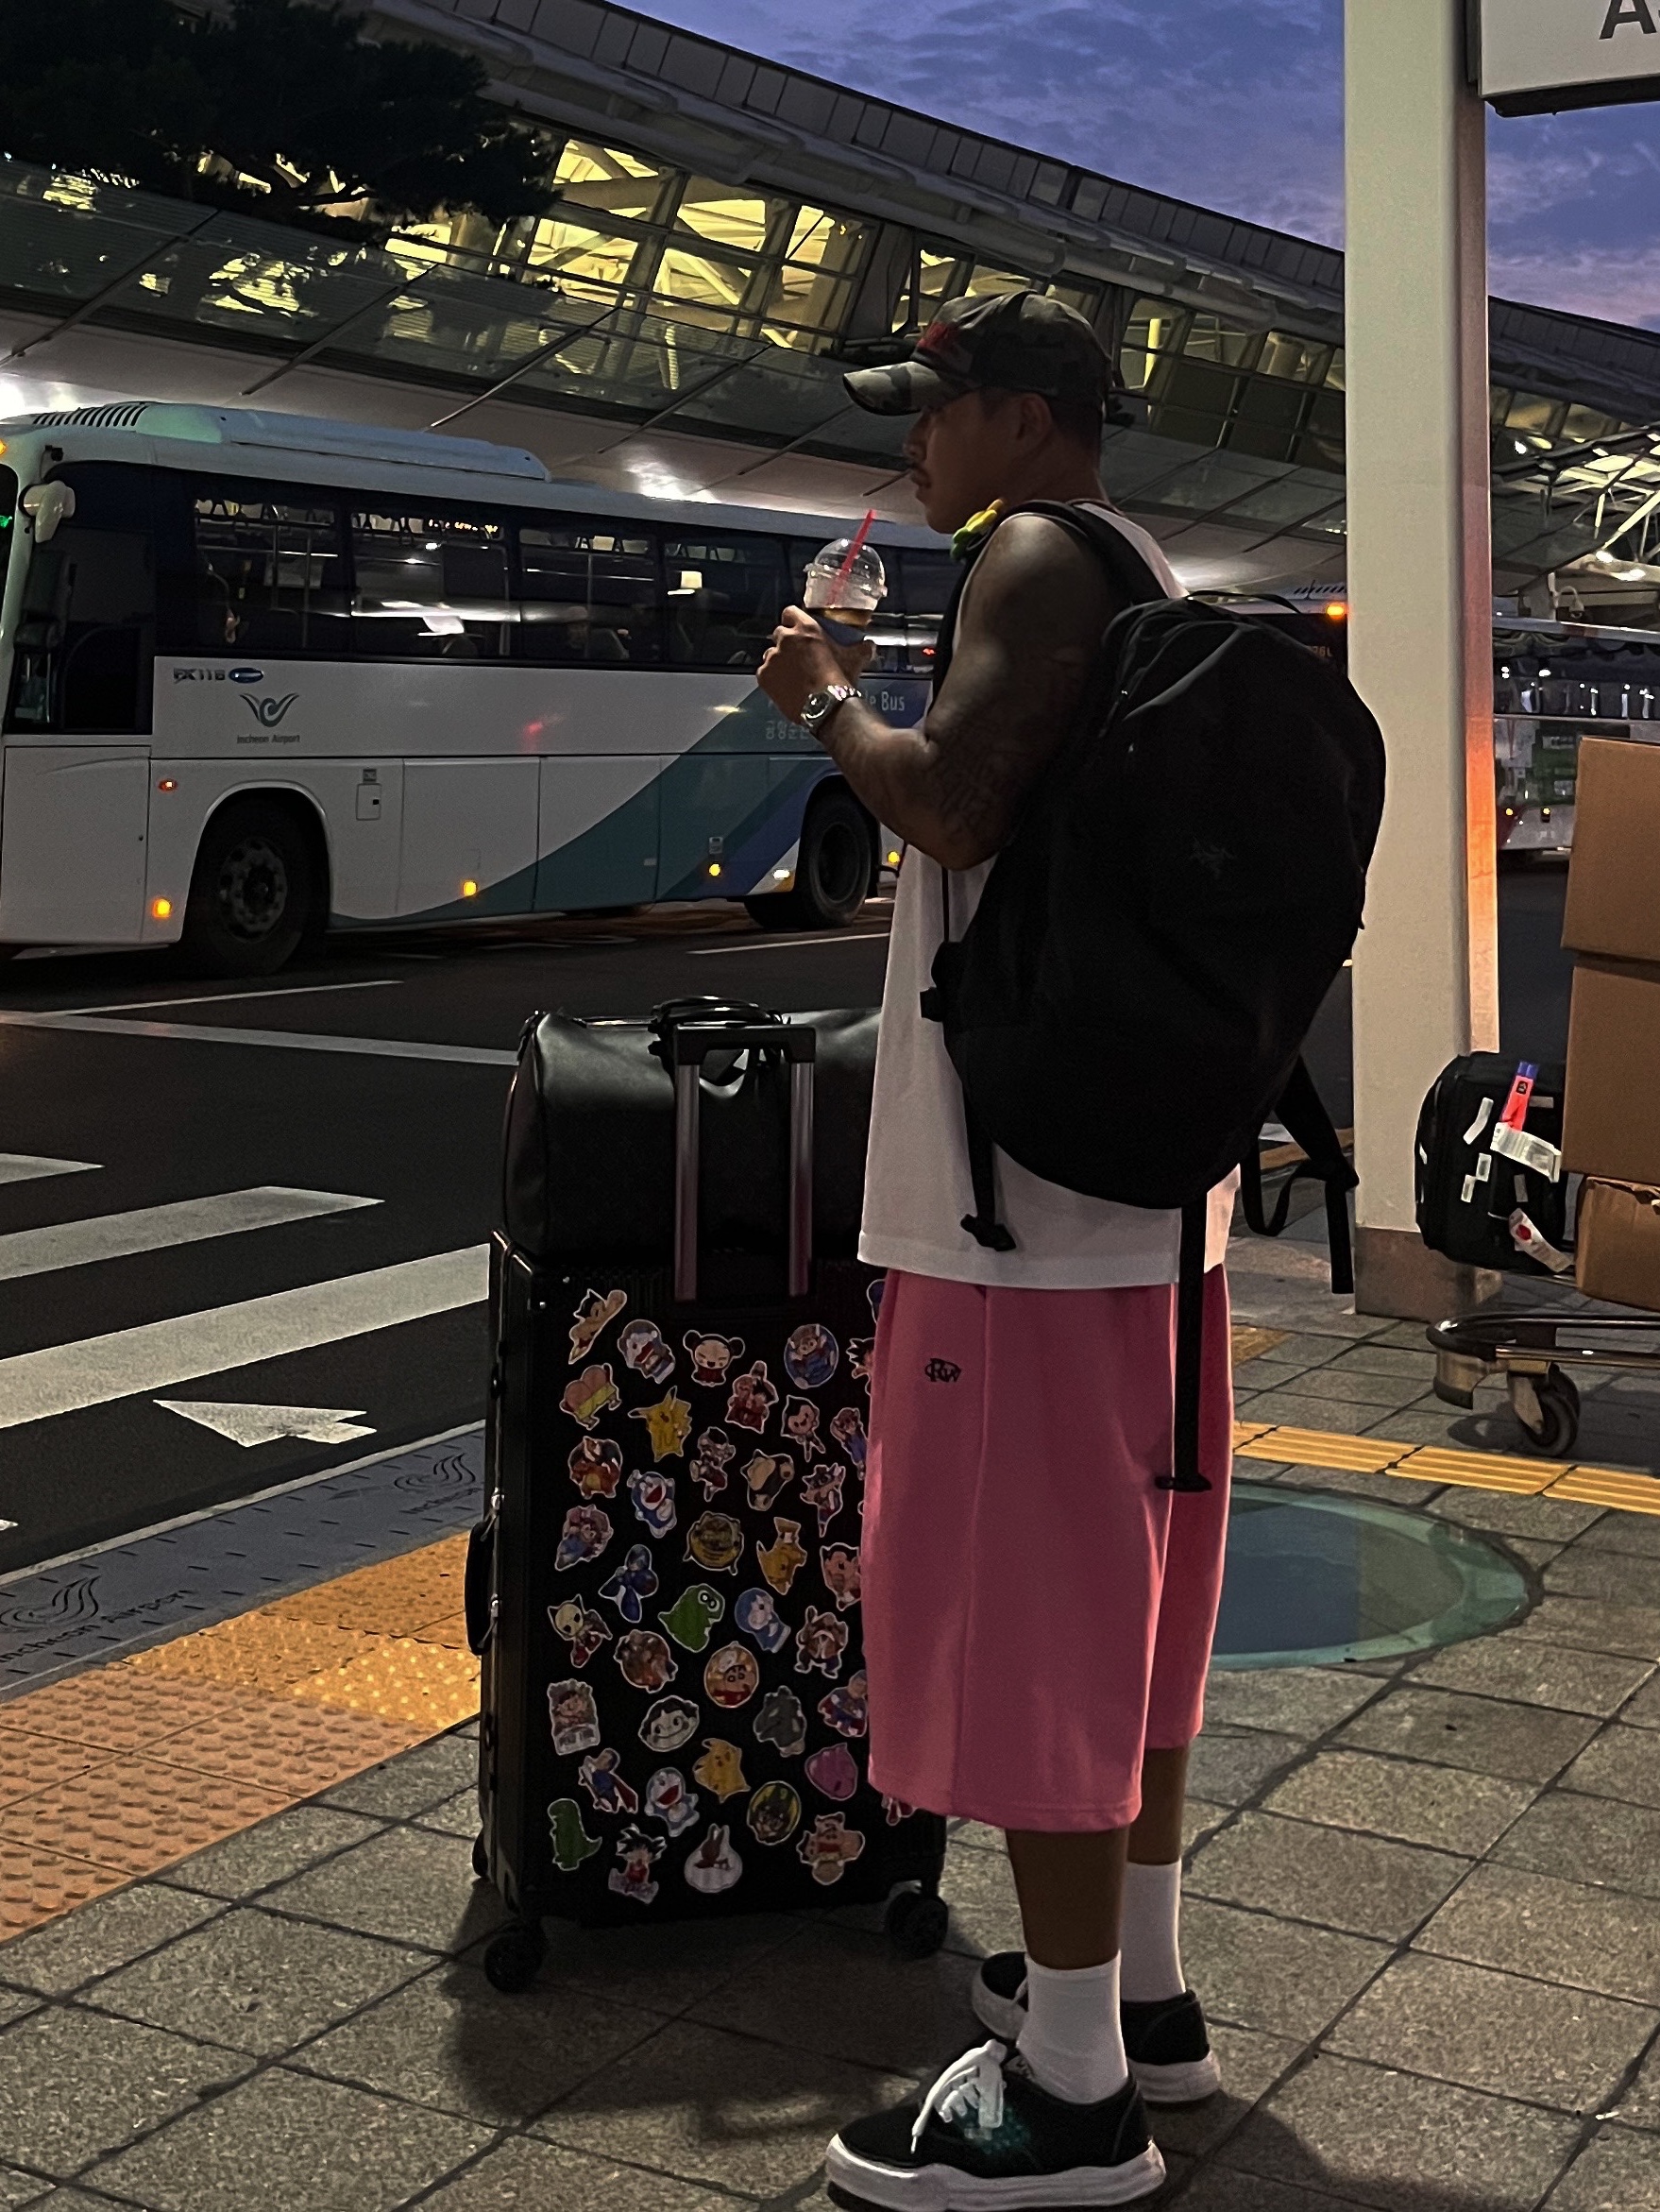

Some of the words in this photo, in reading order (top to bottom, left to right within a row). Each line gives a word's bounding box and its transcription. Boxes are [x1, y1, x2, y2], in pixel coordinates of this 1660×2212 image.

[881, 690, 905, 711] Bus
[237, 734, 269, 744] Incheon
[272, 734, 300, 744] Airport
